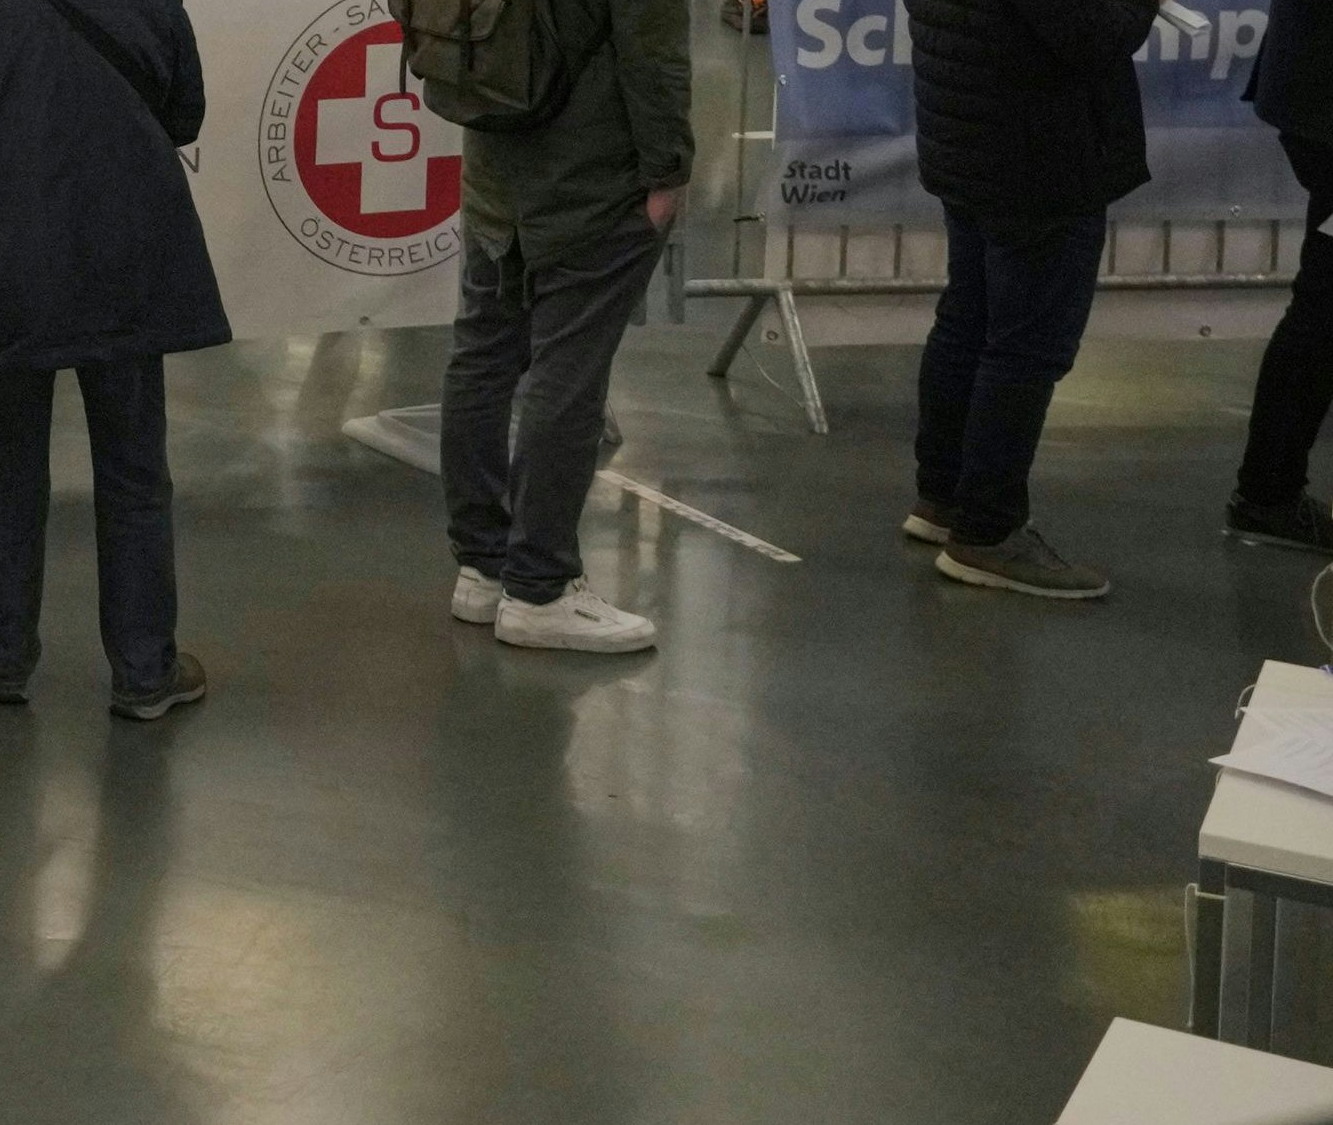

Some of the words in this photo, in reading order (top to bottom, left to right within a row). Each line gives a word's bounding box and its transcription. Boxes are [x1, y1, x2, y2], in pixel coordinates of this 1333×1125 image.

[267, 32, 328, 183] ARBEITER
[371, 91, 421, 163] S
[780, 182, 846, 205] Wien
[787, 159, 852, 182] Stadt
[300, 217, 461, 268] ÖSTERREIC
